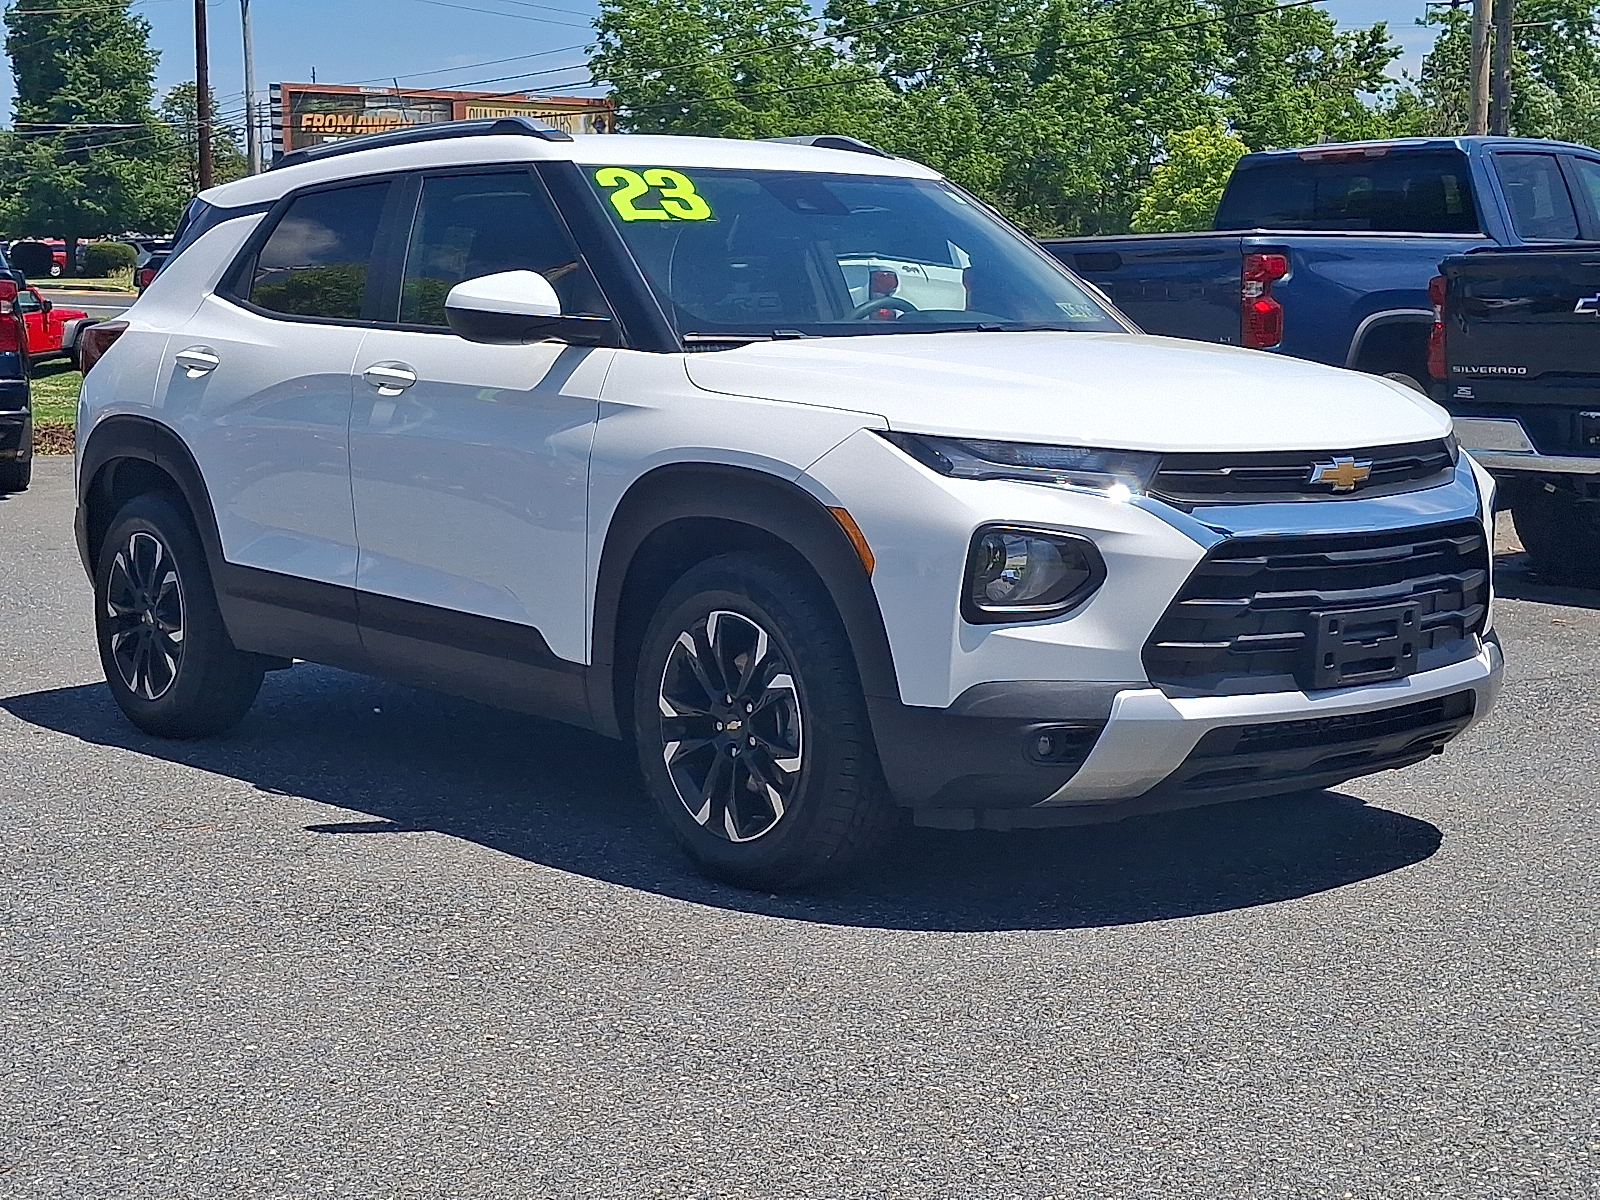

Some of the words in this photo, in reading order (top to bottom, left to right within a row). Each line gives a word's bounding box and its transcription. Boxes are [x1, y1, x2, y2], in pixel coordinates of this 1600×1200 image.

[301, 113, 353, 133] FROM
[594, 167, 712, 222] 23
[1452, 365, 1528, 375] SILVERADO
